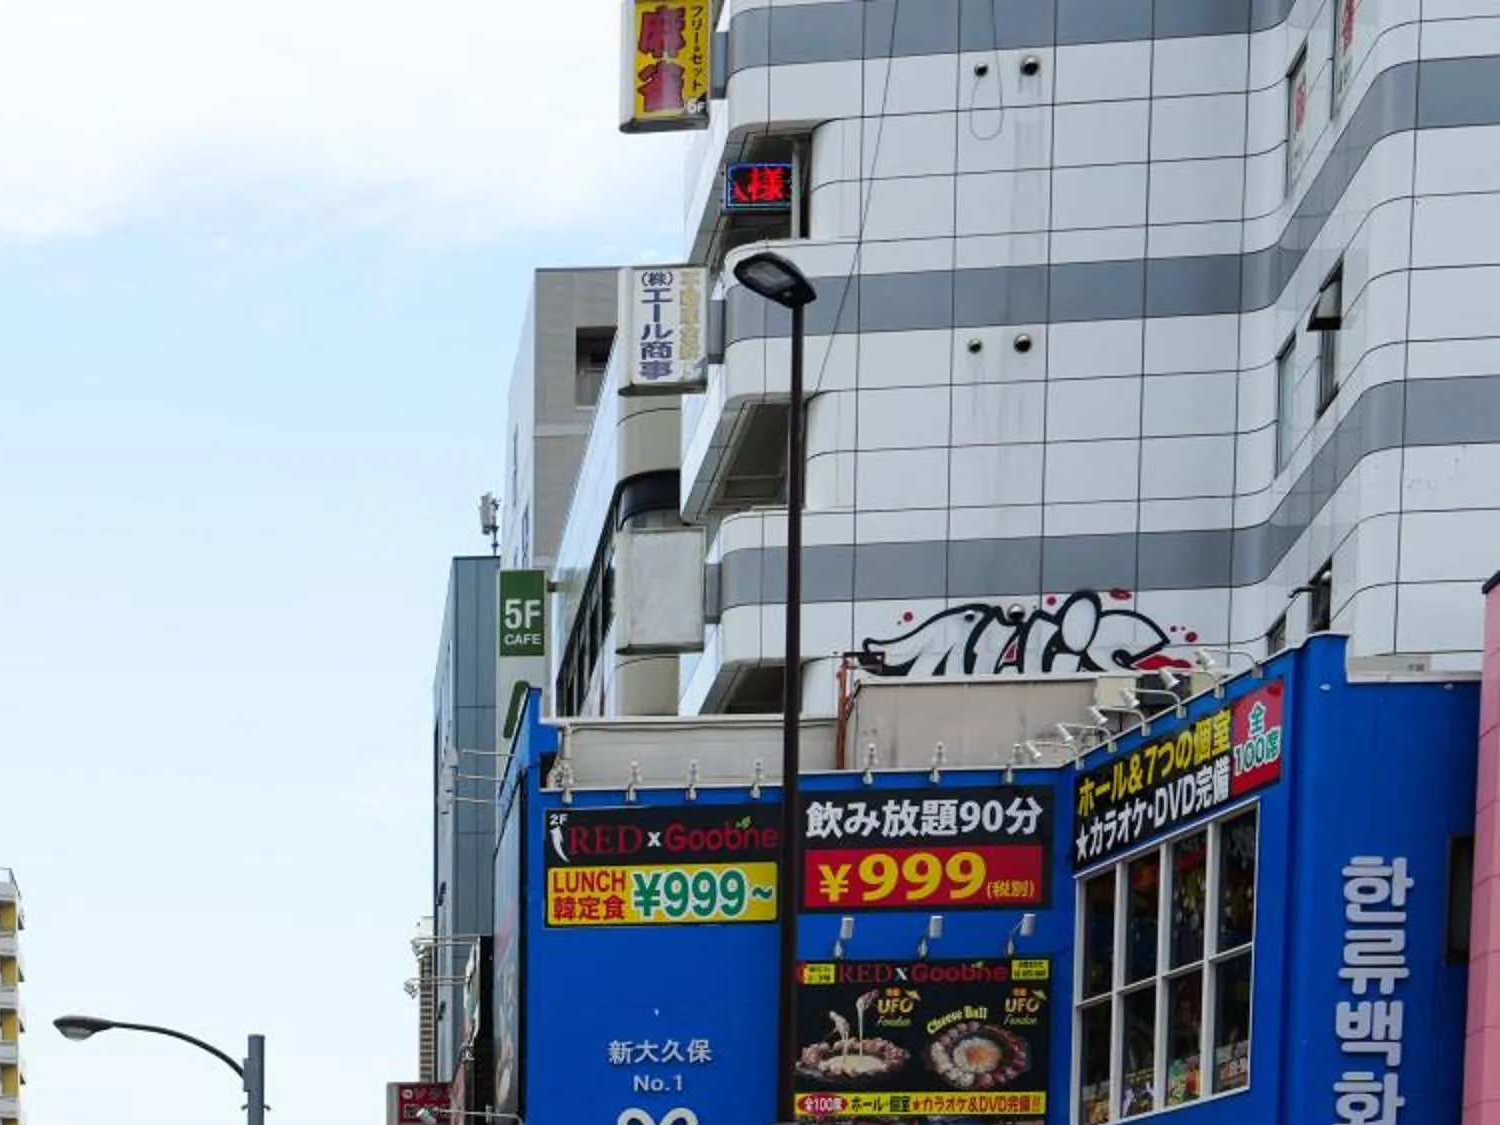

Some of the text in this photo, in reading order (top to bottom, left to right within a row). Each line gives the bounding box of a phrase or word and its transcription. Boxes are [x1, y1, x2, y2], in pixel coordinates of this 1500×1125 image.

[504, 598, 541, 629] 5F
[504, 633, 541, 645] CAFE
[805, 797, 1043, 838] 飲み放題90分
[569, 824, 643, 856] RED
[665, 820, 780, 852] Goobne
[553, 870, 627, 893] LUNCH
[818, 851, 987, 902] ¥999
[553, 895, 626, 921] 韓定食
[877, 997, 914, 1014] UFO
[964, 1005, 989, 1021] Ball
[1005, 997, 1040, 1013] UFO
[608, 1039, 713, 1065] 新大久保
[633, 1074, 683, 1092] No.1
